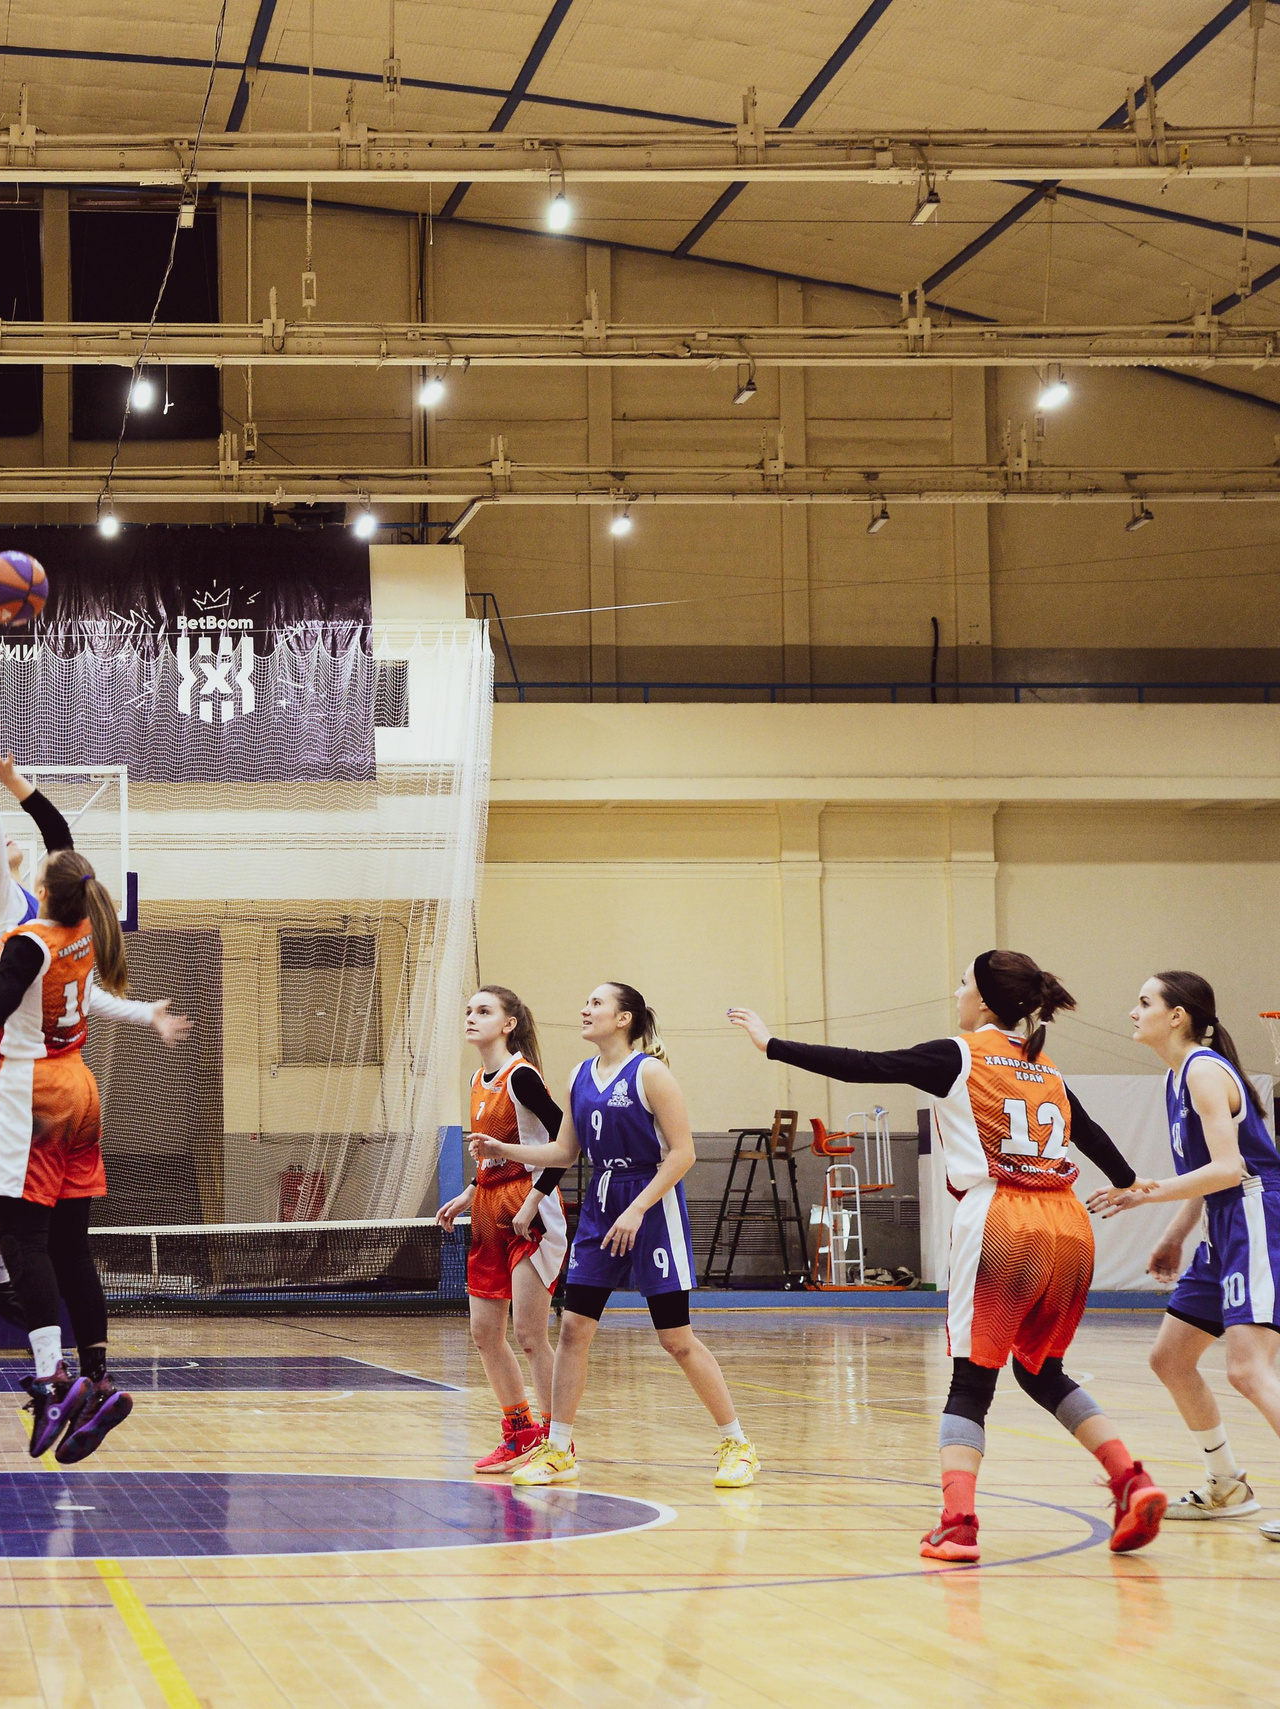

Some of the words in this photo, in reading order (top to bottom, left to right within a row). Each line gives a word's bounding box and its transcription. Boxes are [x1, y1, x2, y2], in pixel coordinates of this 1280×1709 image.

[176, 615, 254, 630] BetBoom
[1015, 1070, 1045, 1084] КРАЙ
[591, 1109, 603, 1141] 9
[1000, 1097, 1069, 1160] 12
[652, 1247, 670, 1279] 9
[1222, 1271, 1246, 1310] 10
